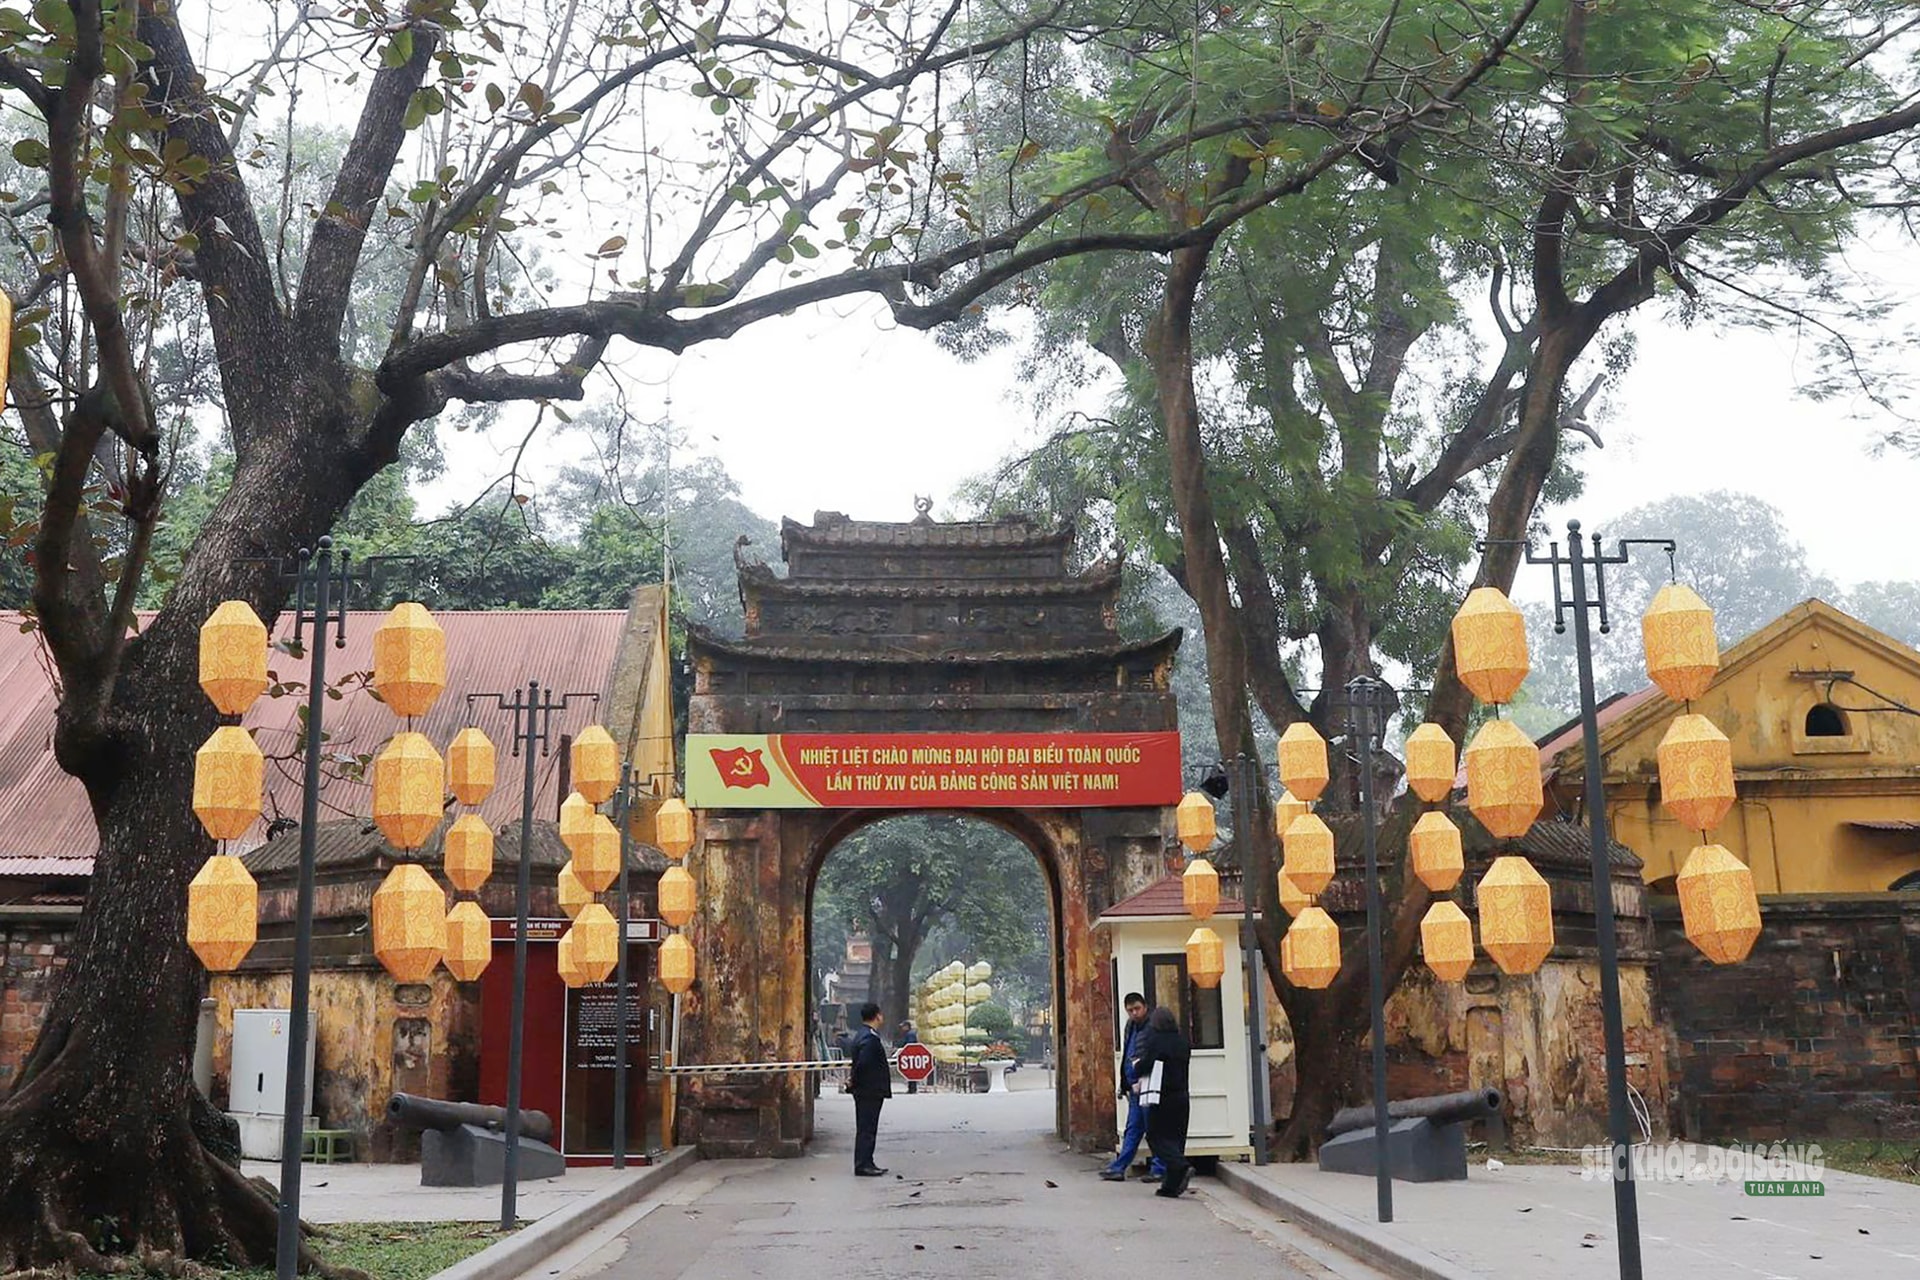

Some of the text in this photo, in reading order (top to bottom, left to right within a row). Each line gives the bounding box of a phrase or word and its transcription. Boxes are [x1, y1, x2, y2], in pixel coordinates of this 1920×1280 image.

[800, 742, 1141, 768] NHIỆT LIỆT CHÀO MỪNG ĐẠI HỘI ĐẠI BIỂU TOÀN QUỐC
[856, 772, 882, 791] THỨ
[885, 775, 907, 791] XIV
[910, 770, 937, 791] CỦA
[940, 770, 977, 791] ĐẢNG
[980, 771, 1017, 793] CỘNG
[1021, 769, 1048, 790] SẢN
[1051, 771, 1080, 793] VIỆT
[1083, 774, 1119, 790] NAM!
[900, 1055, 930, 1069] STOP
